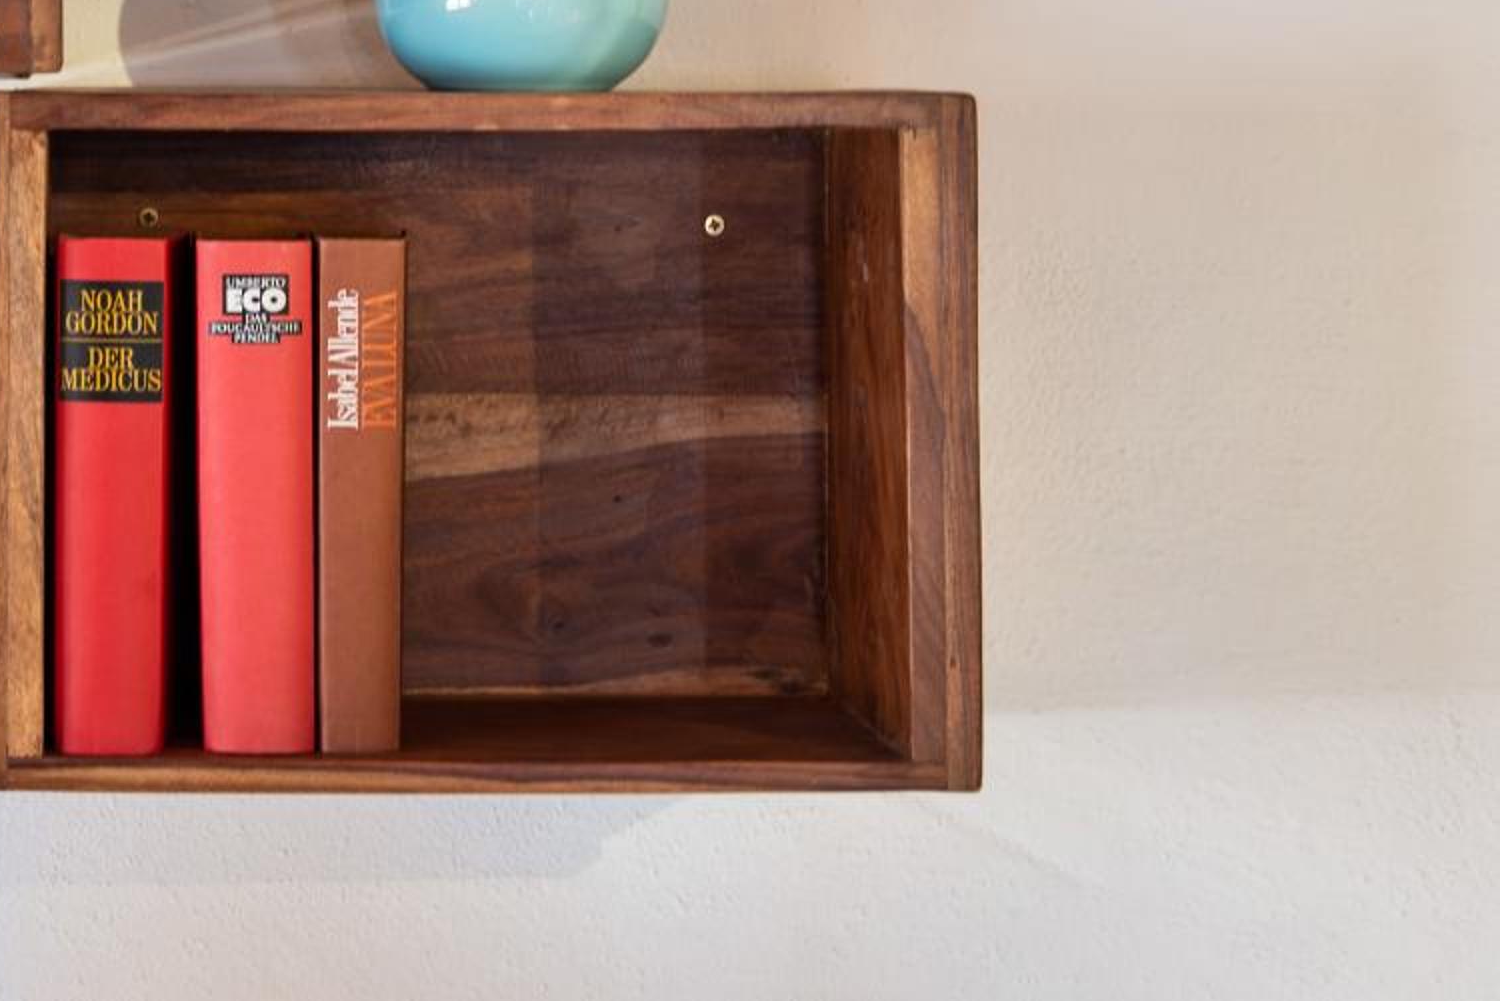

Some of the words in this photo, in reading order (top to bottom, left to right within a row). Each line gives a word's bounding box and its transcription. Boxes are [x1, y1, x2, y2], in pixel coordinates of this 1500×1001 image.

[225, 276, 287, 289] UMBERTO
[80, 289, 143, 313] NOAH
[225, 288, 287, 313] ECO
[65, 311, 159, 336] GORDON
[244, 313, 268, 323] DAS
[327, 287, 359, 365] Allende
[362, 291, 397, 369] LUNA
[233, 332, 279, 343] PENDEL
[87, 346, 135, 369] DER
[61, 367, 163, 393] MEDICUS
[327, 368, 359, 431] Isabel
[362, 374, 397, 431] EVA
